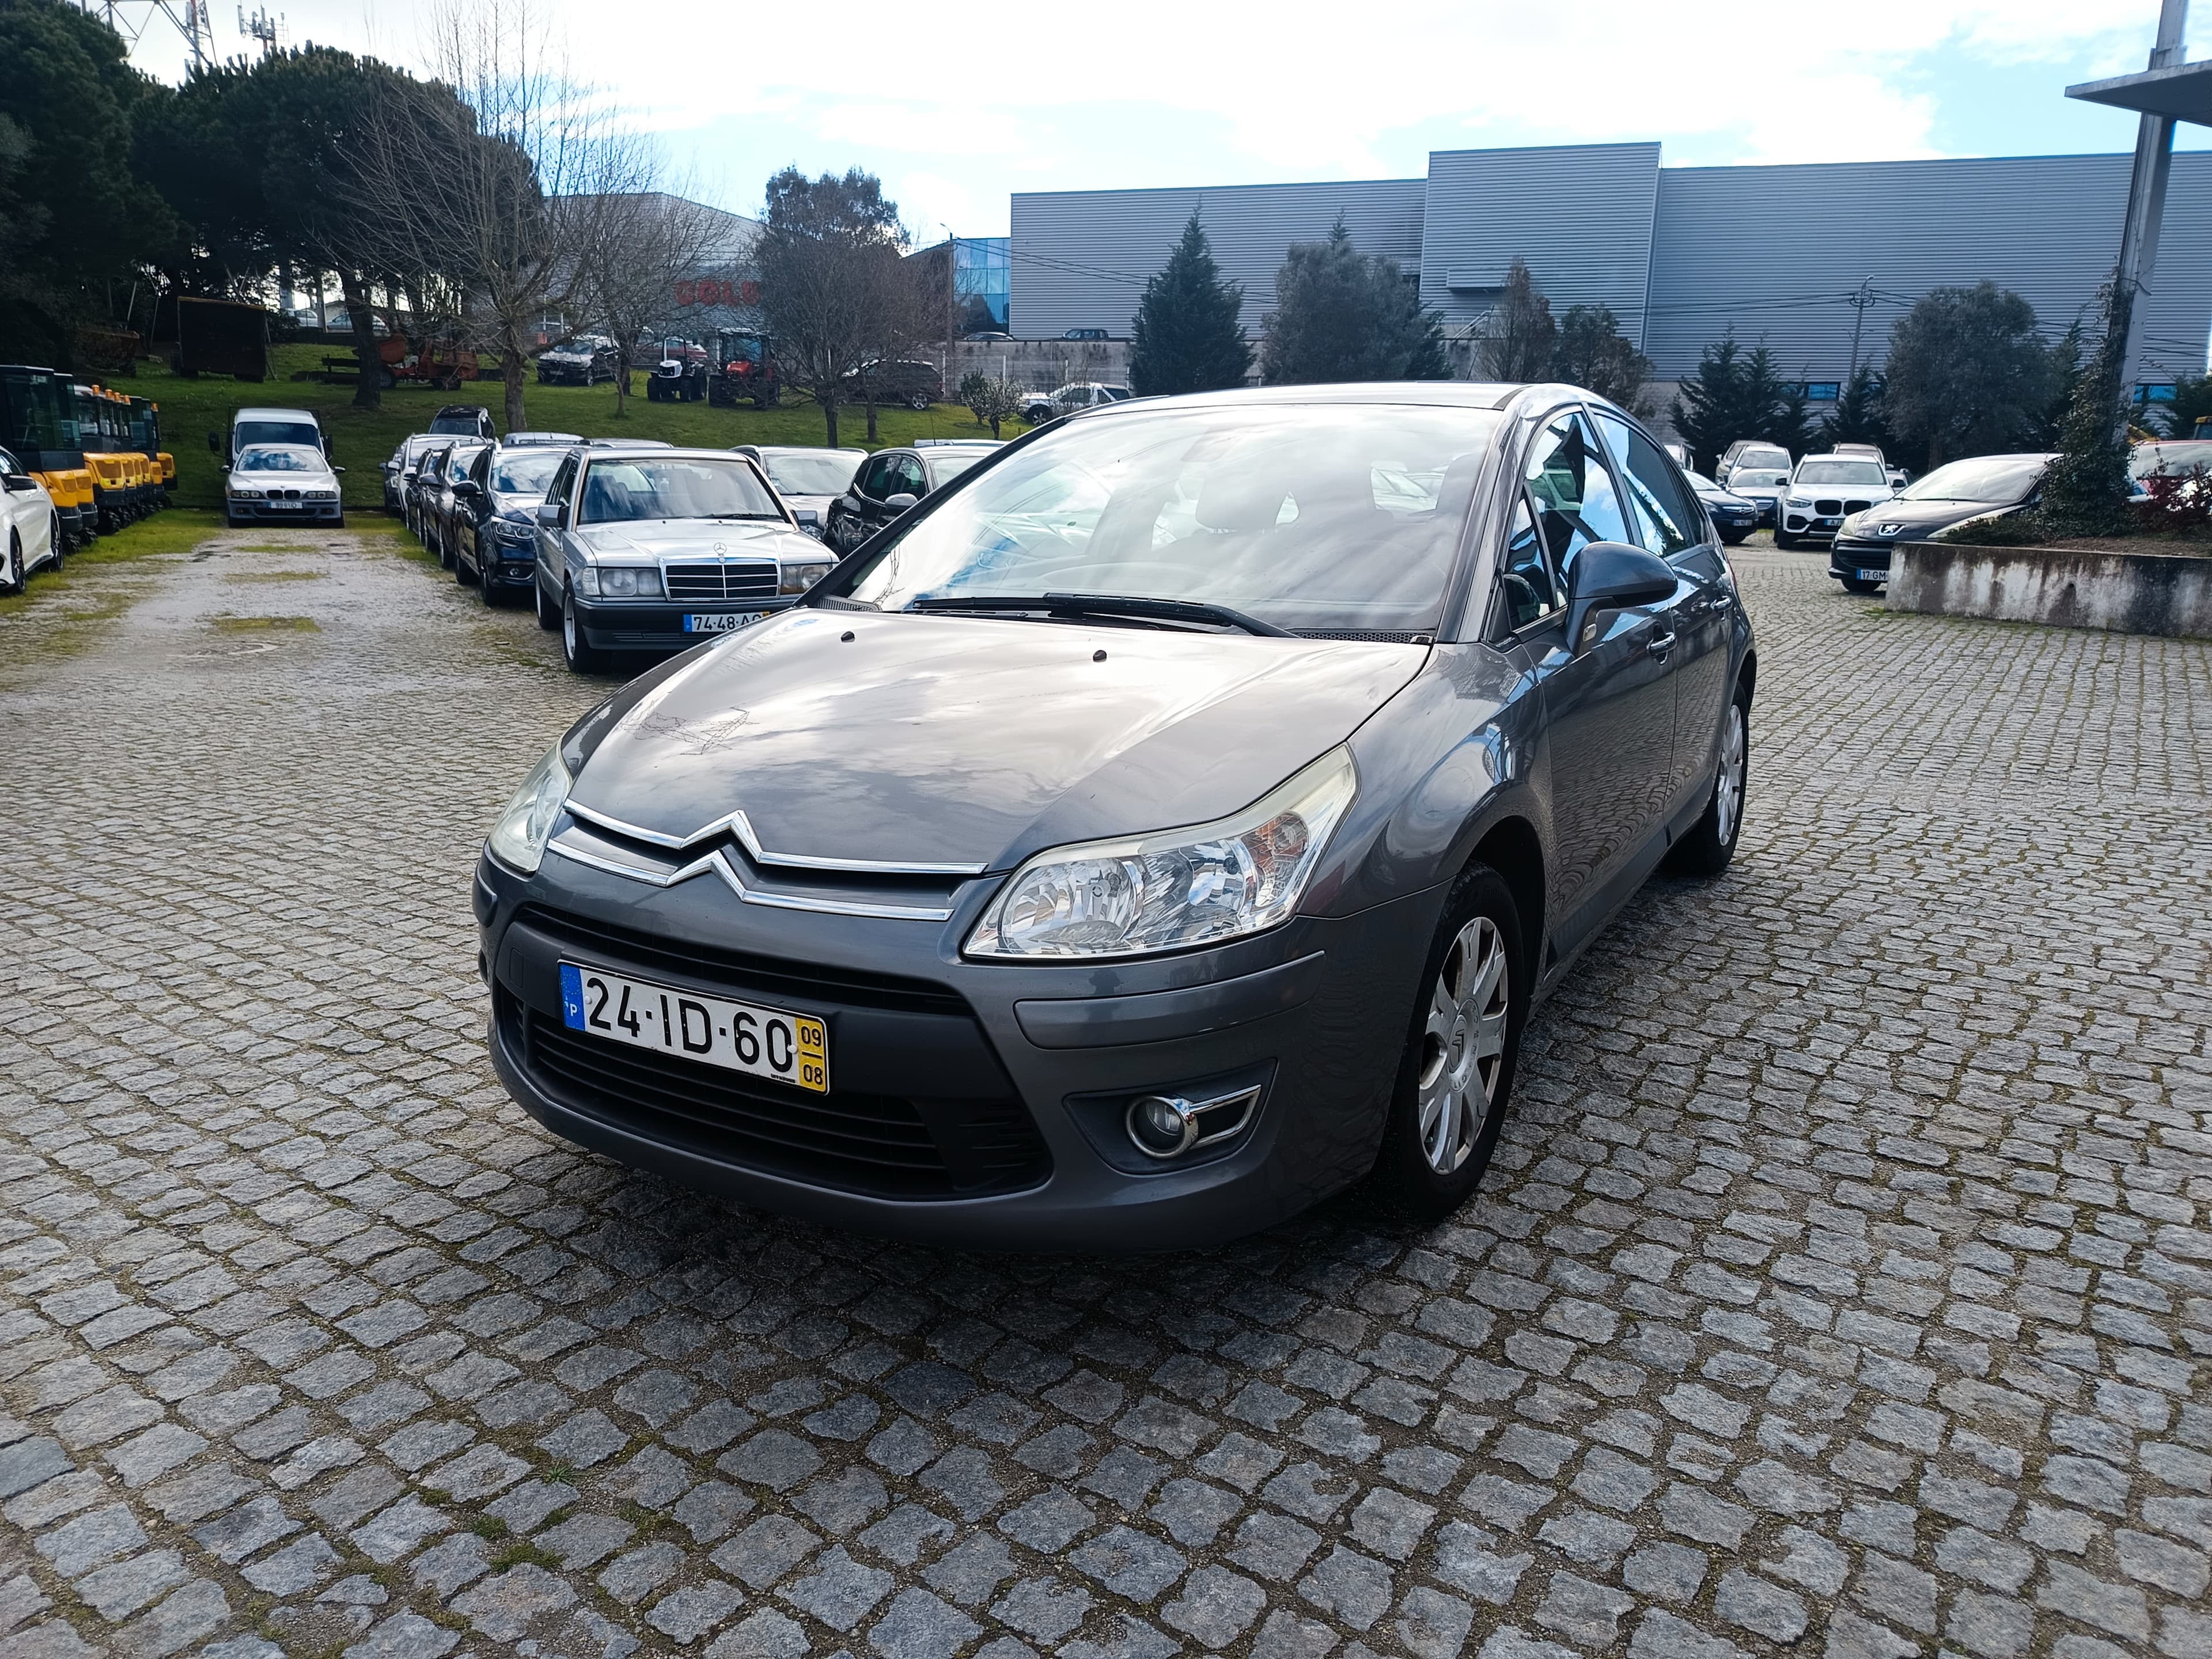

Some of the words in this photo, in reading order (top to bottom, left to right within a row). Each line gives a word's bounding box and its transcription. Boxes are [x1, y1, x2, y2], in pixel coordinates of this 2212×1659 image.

[570, 1003, 578, 1017] P
[801, 1025, 821, 1047] 09
[803, 1063, 823, 1085] 08
